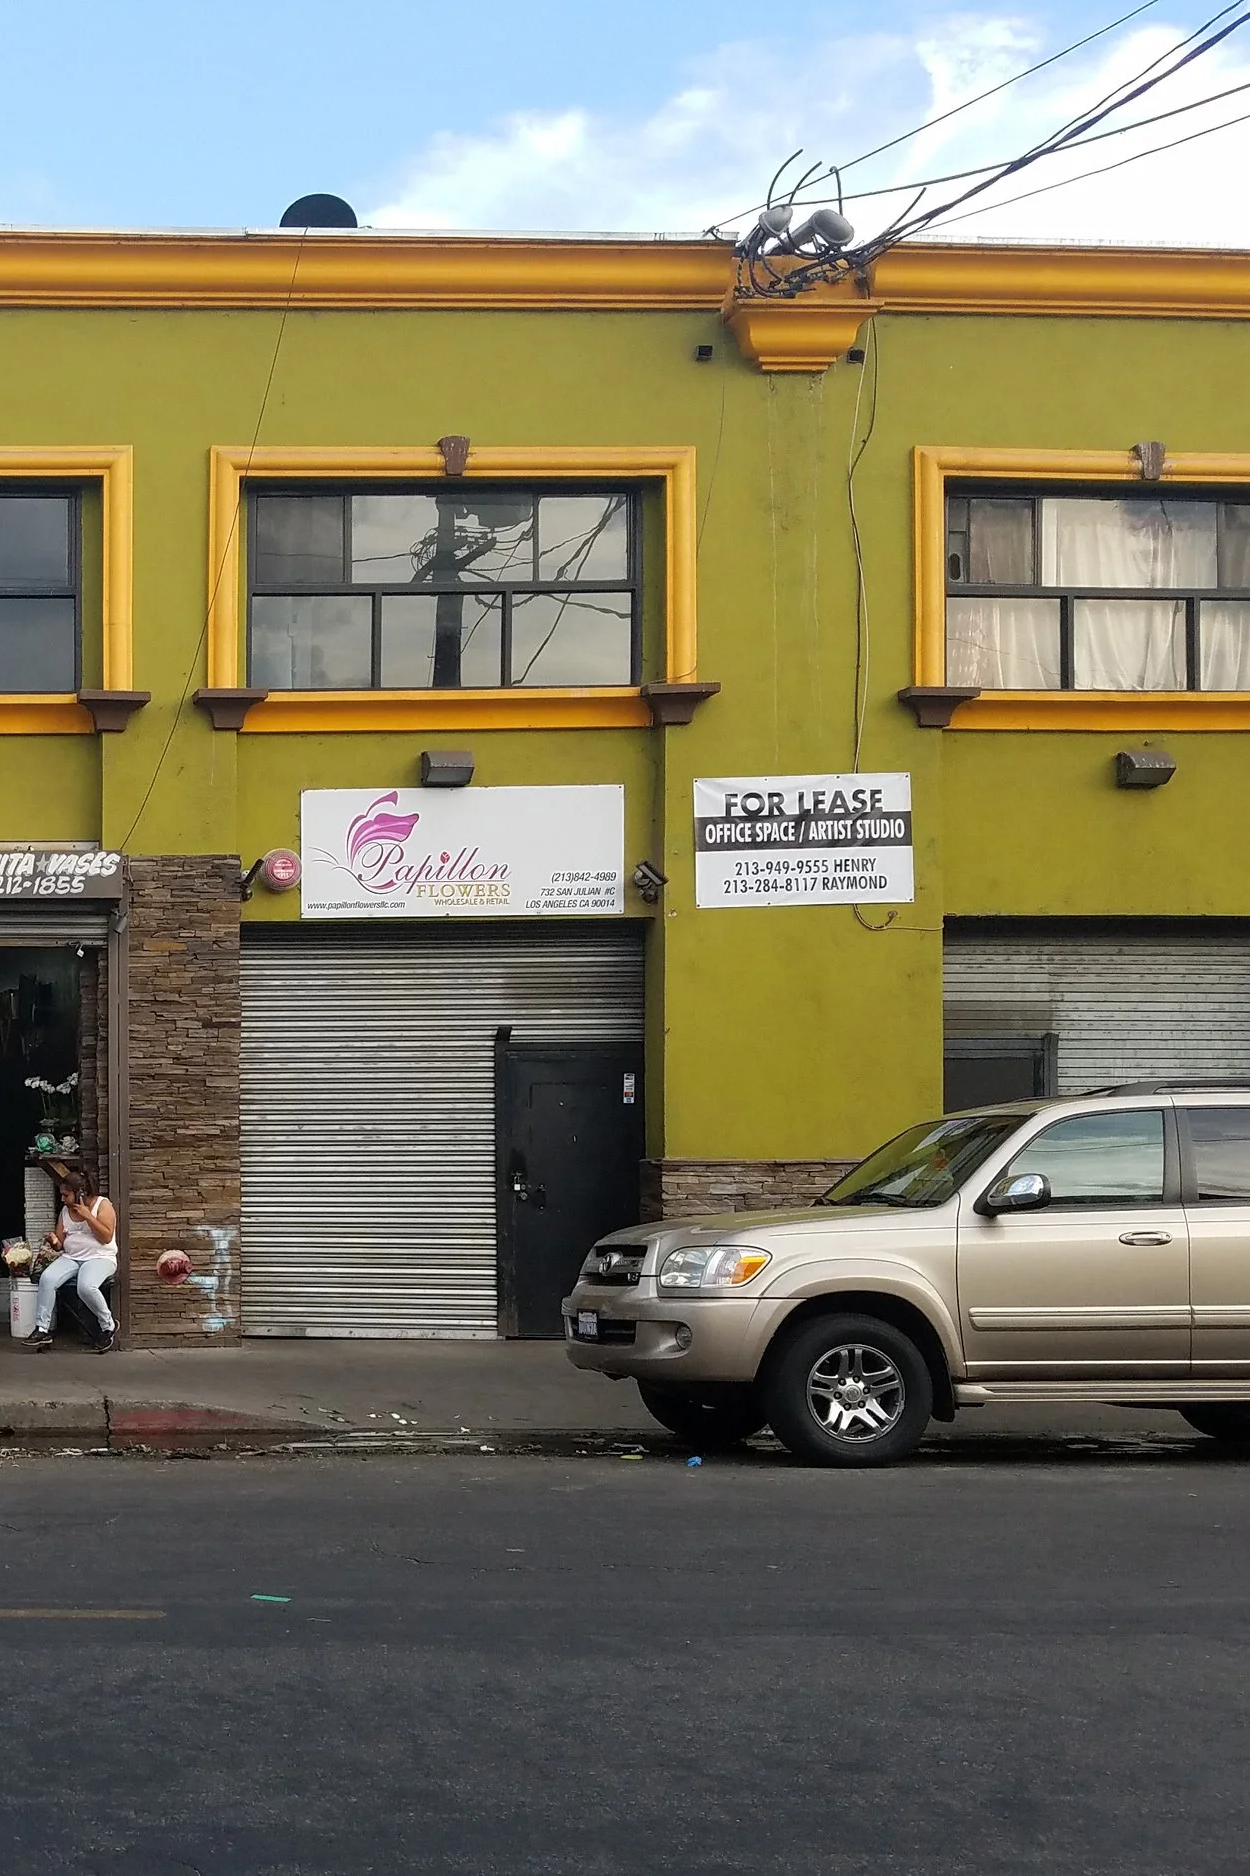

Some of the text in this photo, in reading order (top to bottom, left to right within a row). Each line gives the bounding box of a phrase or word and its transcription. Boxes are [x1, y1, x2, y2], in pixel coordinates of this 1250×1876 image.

[725, 788, 883, 818] FOR LEASE
[705, 818, 905, 844] OFFICE SPACE / ARTIST STUDIO
[48, 851, 121, 877] VASES
[357, 842, 513, 895] Papillon
[735, 858, 877, 876] 213-949-9555 HENRY
[551, 872, 617, 884] (213)842-4989
[723, 875, 888, 894] 213-284-8117 RAYMOND
[416, 883, 512, 899] FLOWERS
[540, 886, 616, 897] 732 SAN JULIAN #C
[434, 898, 479, 906] WHOLESALE
[486, 897, 511, 905] RETAIL
[525, 899, 615, 909] LOS ANGELES CA 90014
